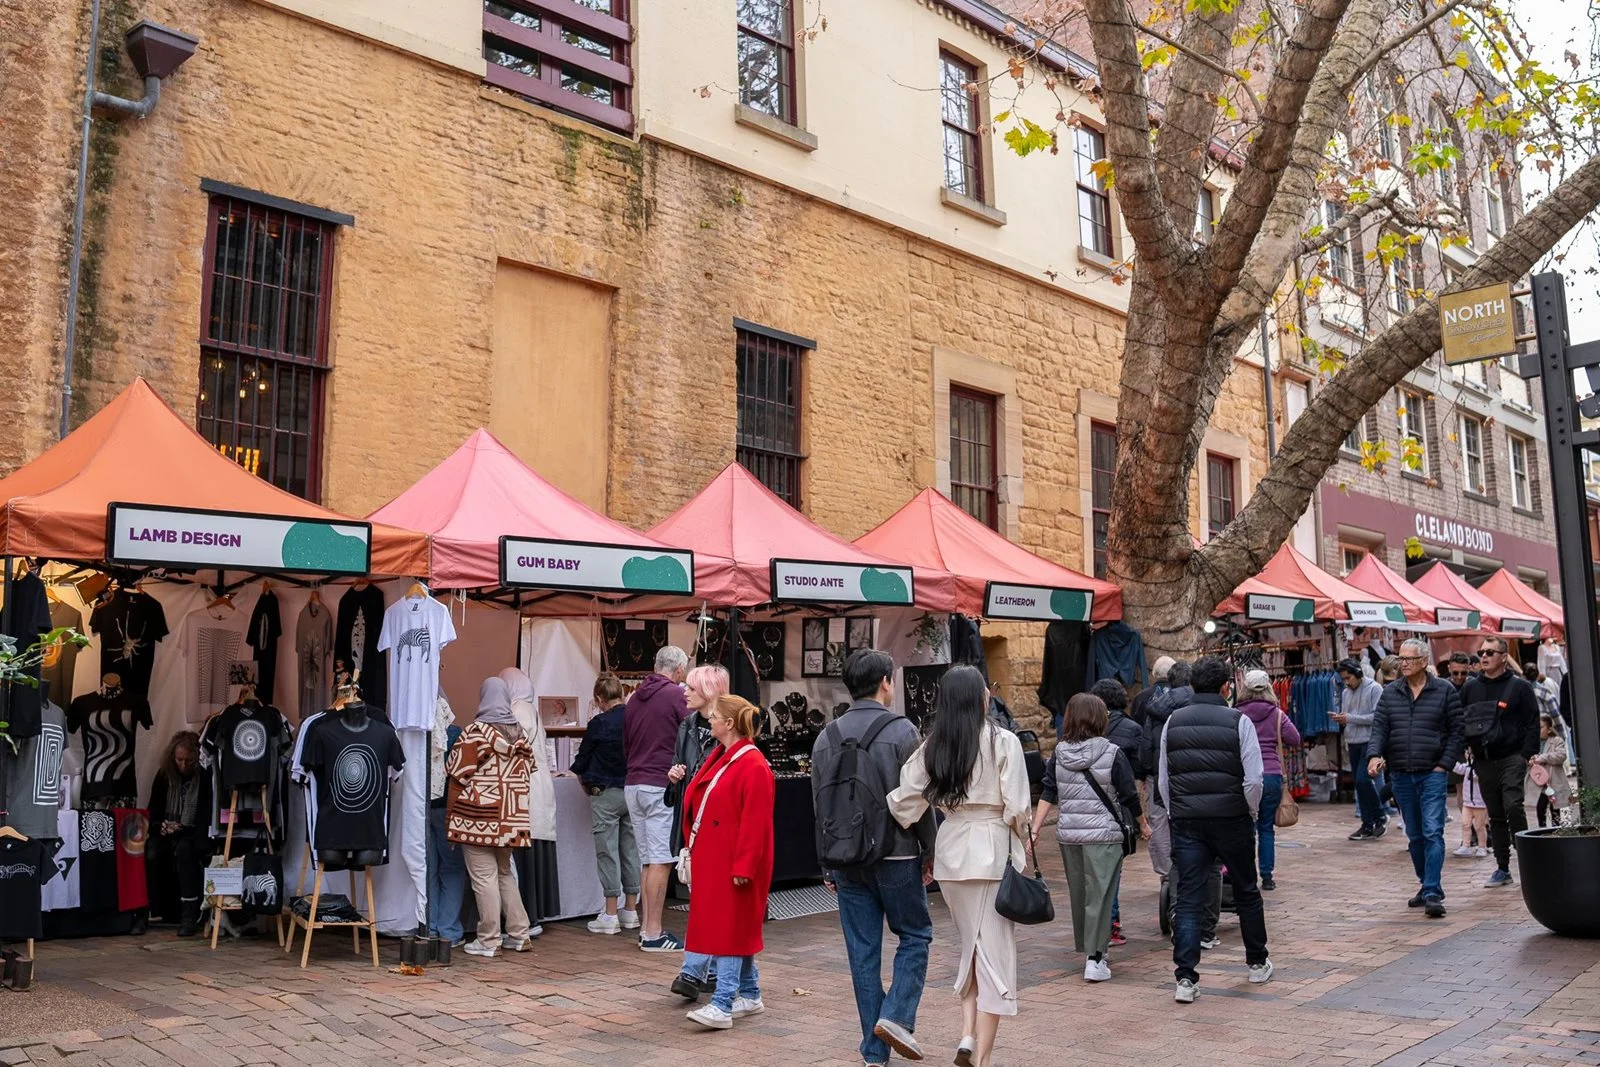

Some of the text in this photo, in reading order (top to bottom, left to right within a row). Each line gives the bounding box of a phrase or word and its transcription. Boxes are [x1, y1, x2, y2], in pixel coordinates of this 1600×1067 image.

[1444, 298, 1506, 325] NORTH
[129, 527, 242, 548] LAMB DESIGN
[516, 555, 581, 571] GUM BABY
[784, 575, 845, 588] STUDIO ANTE
[994, 595, 1036, 607] LEATHERON
[1252, 603, 1271, 611] GARAGE
